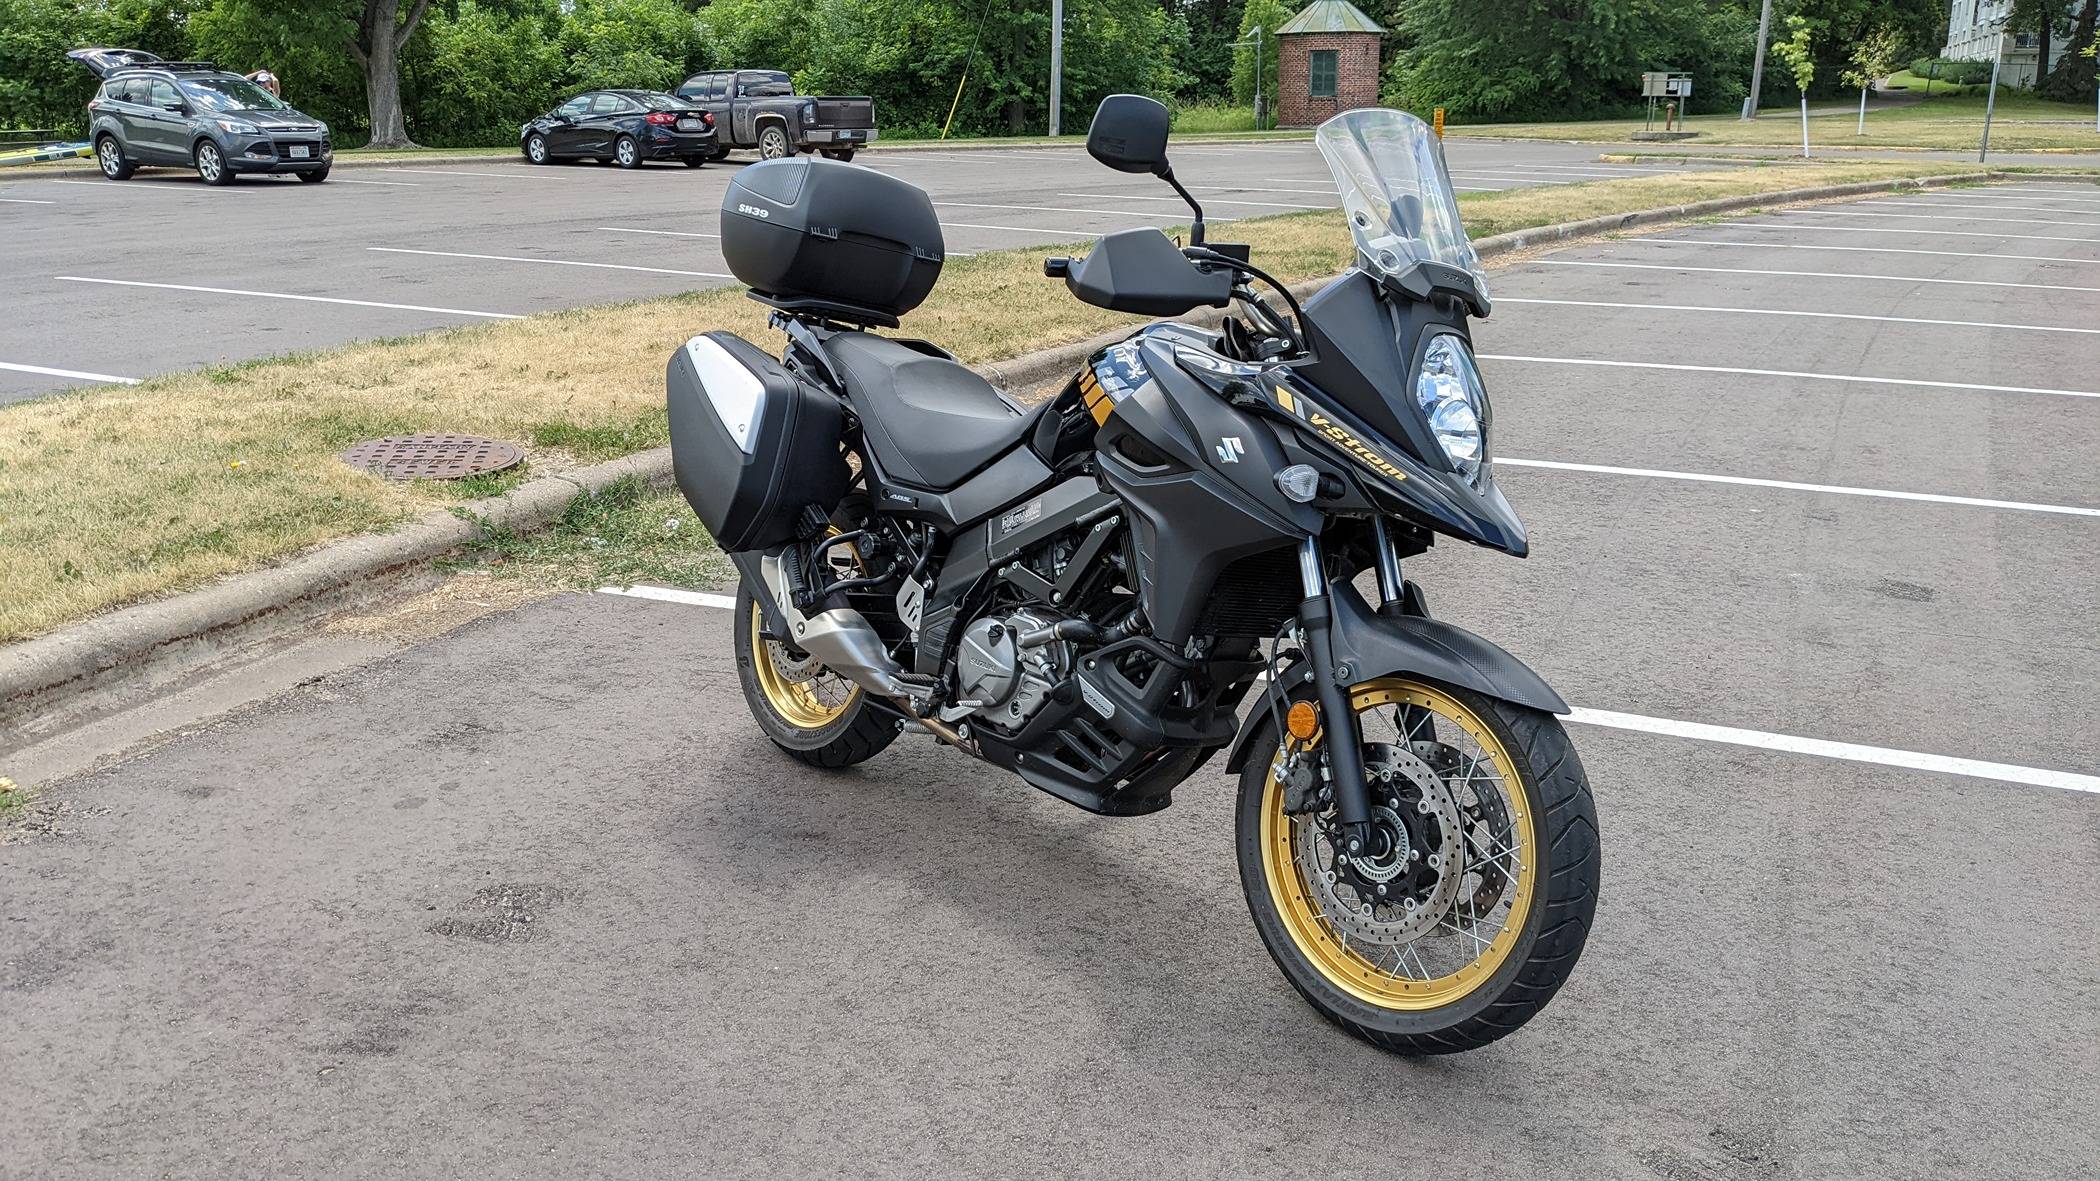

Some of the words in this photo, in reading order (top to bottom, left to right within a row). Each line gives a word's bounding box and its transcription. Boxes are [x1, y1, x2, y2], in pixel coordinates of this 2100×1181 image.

[738, 203, 769, 218] SH39
[1310, 412, 1408, 481] V-Strom
[1334, 441, 1368, 463] ADVENTURE
[1366, 462, 1388, 477] TOURER
[889, 494, 913, 504] ABS
